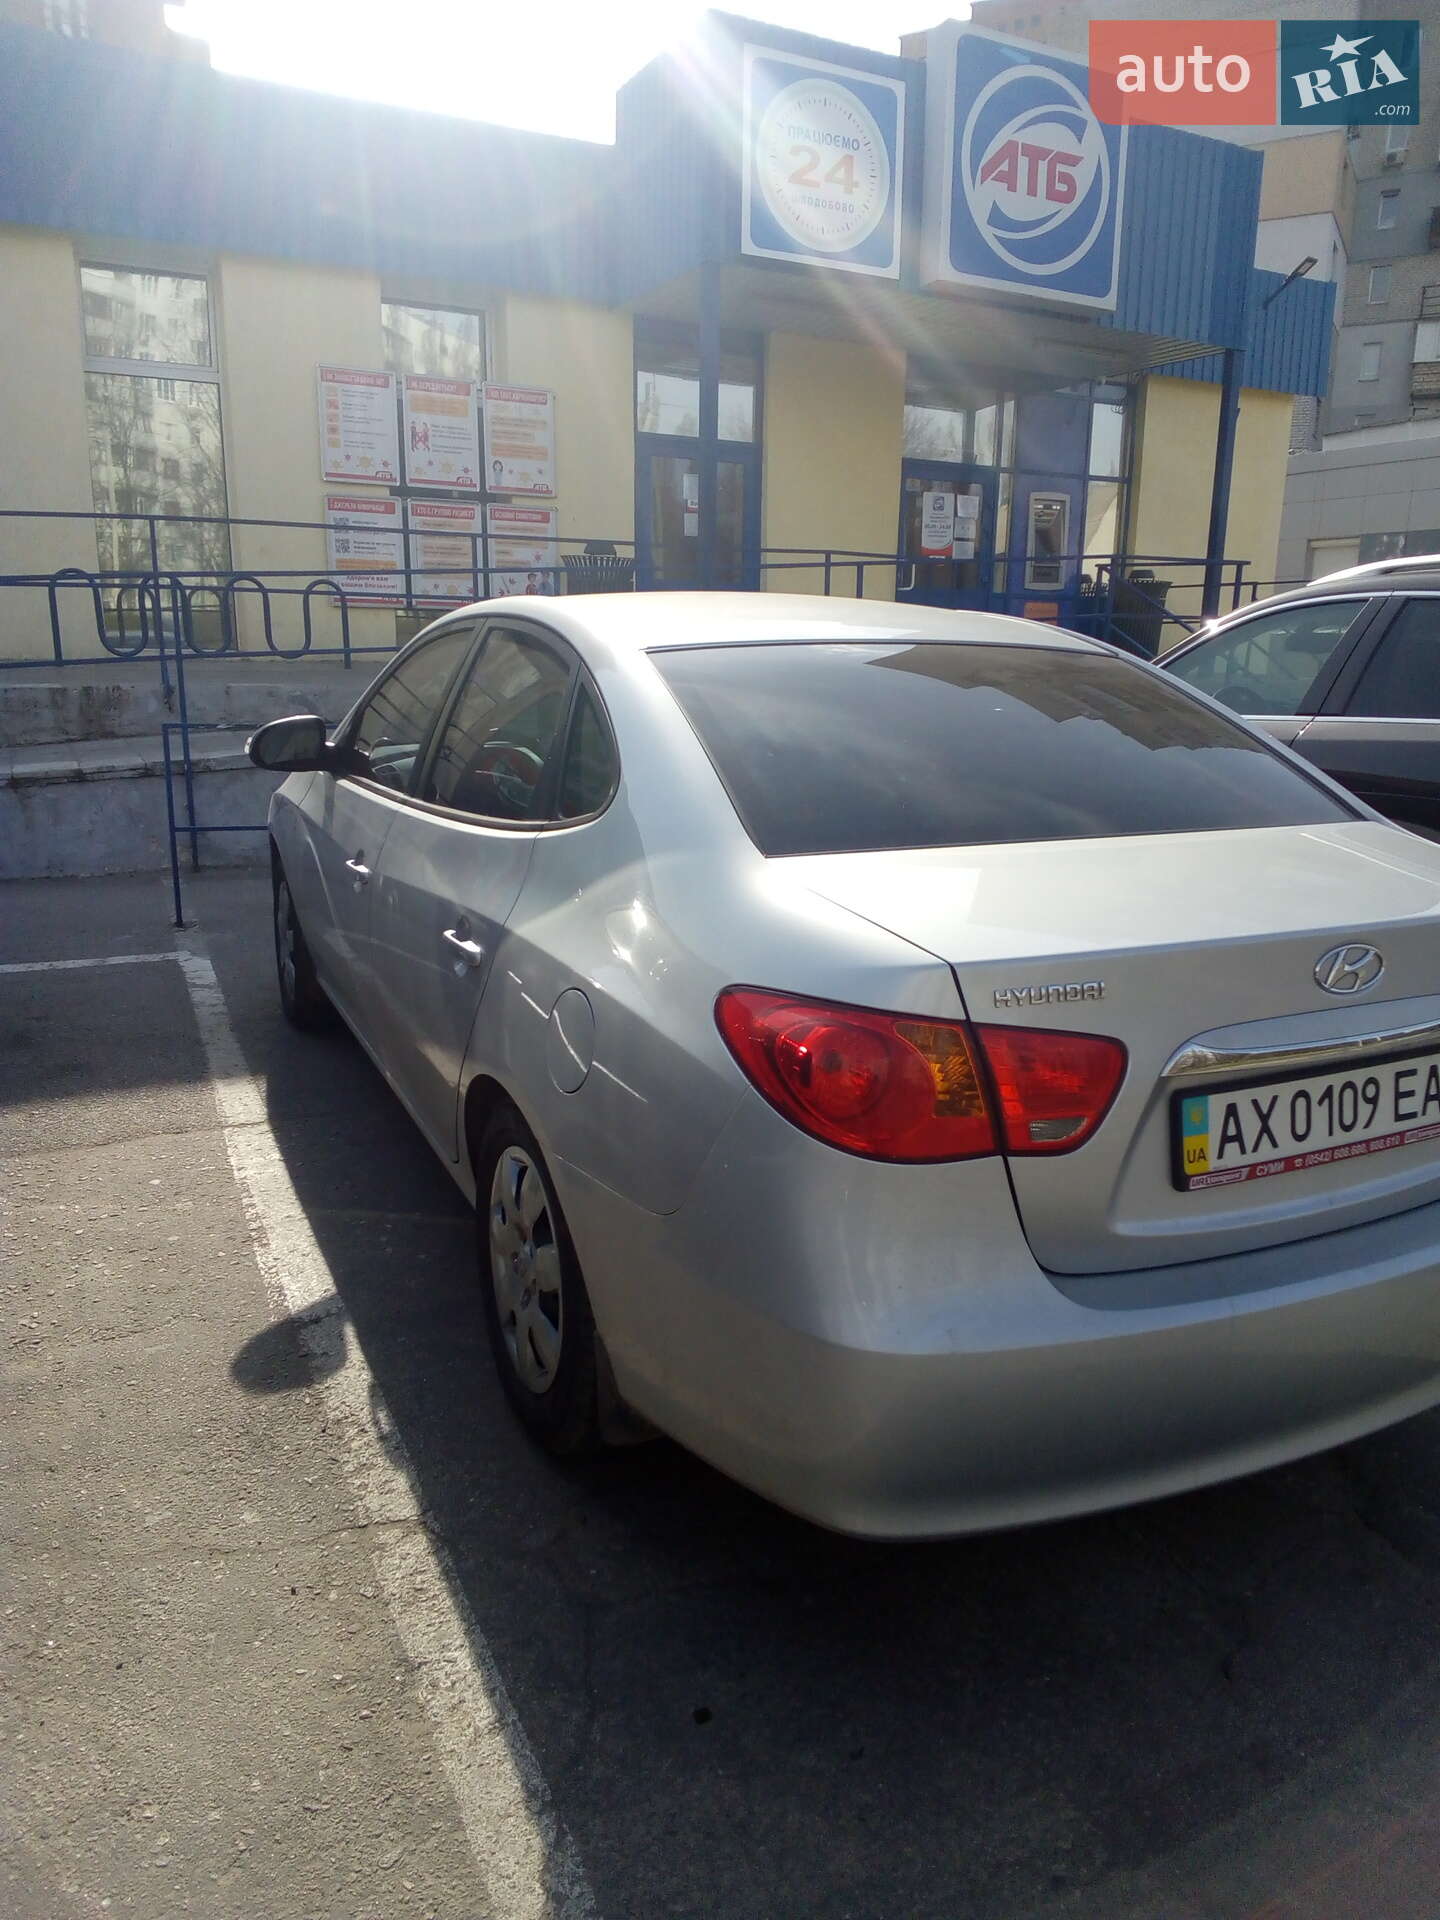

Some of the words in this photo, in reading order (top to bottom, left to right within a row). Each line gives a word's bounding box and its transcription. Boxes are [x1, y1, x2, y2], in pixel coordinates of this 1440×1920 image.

[787, 144, 860, 193] 24
[980, 139, 1085, 204] АТБ
[993, 980, 1105, 1009] HYUNDAI
[1290, 1076, 1380, 1142] 0109
[1187, 1148, 1208, 1164] UA
